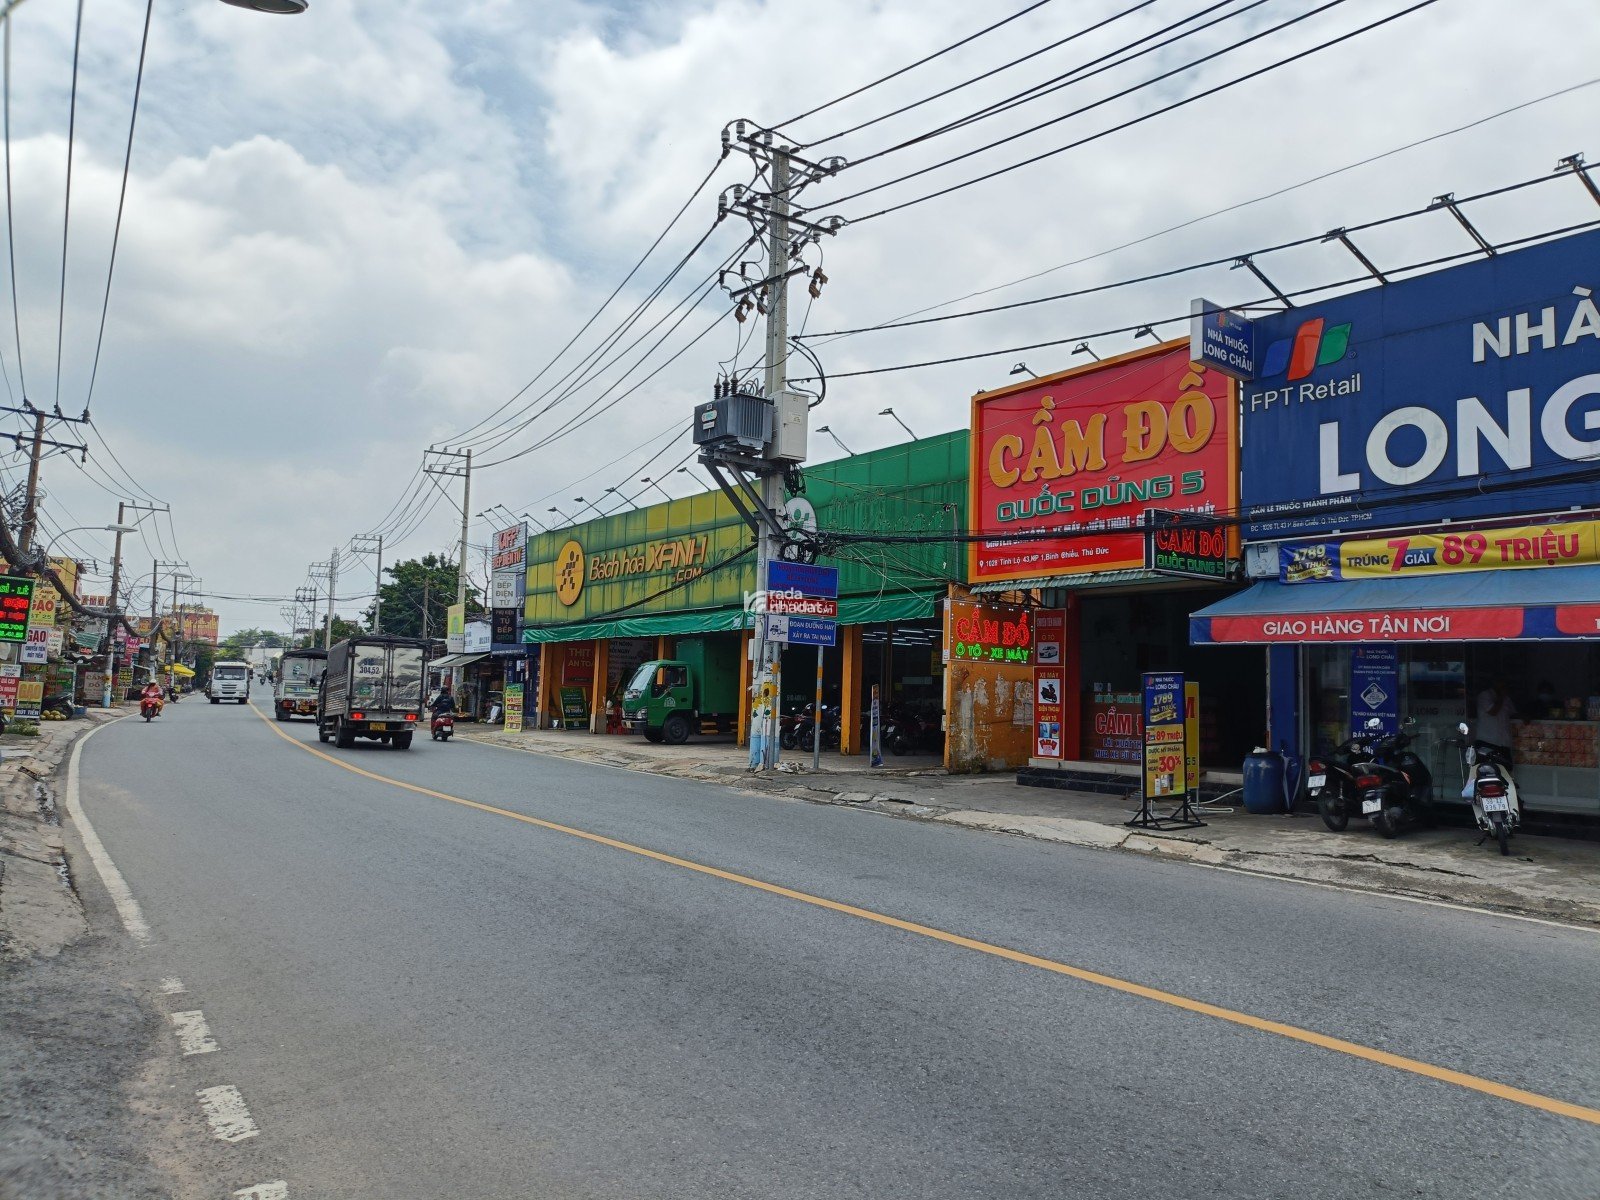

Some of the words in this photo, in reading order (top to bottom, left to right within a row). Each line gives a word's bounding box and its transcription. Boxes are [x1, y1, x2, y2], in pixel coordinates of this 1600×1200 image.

[1208, 328, 1223, 343] NHÀ
[1225, 335, 1248, 354] THUỐC
[1473, 285, 1600, 363] NHÀ
[1204, 342, 1227, 361] LONG
[1229, 353, 1252, 372] CHÂU
[1251, 387, 1294, 412] FPT
[1300, 373, 1360, 402] Retail
[988, 395, 1108, 488] CẦM
[1122, 361, 1215, 463] ĐỒ
[1319, 373, 1600, 495] LONG
[997, 483, 1074, 522] QUỐC
[1081, 475, 1174, 509] DŨNG
[1181, 470, 1205, 494] 5
[590, 552, 620, 581] Bách
[622, 548, 645, 574] hóa
[646, 534, 708, 572] XANH
[1346, 552, 1390, 568] TRÚNG
[1388, 538, 1410, 572] 7
[1404, 549, 1430, 564] GIẢI
[1442, 534, 1487, 566] 89
[1495, 528, 1579, 566] TRIỆU
[1263, 620, 1307, 636] GIAO
[1311, 615, 1364, 634] HÀNG
[1368, 615, 1408, 638] TẬN
[1413, 616, 1450, 633] NƠI
[956, 642, 966, 656] Ô
[968, 643, 982, 656] TÔ
[991, 647, 1004, 658] XE
[1006, 646, 1028, 660] MÁY
[1154, 692, 1173, 706] 1789
[1156, 730, 1166, 740] 89
[1166, 730, 1182, 742] TRIỆU
[1159, 756, 1182, 772] 30%
